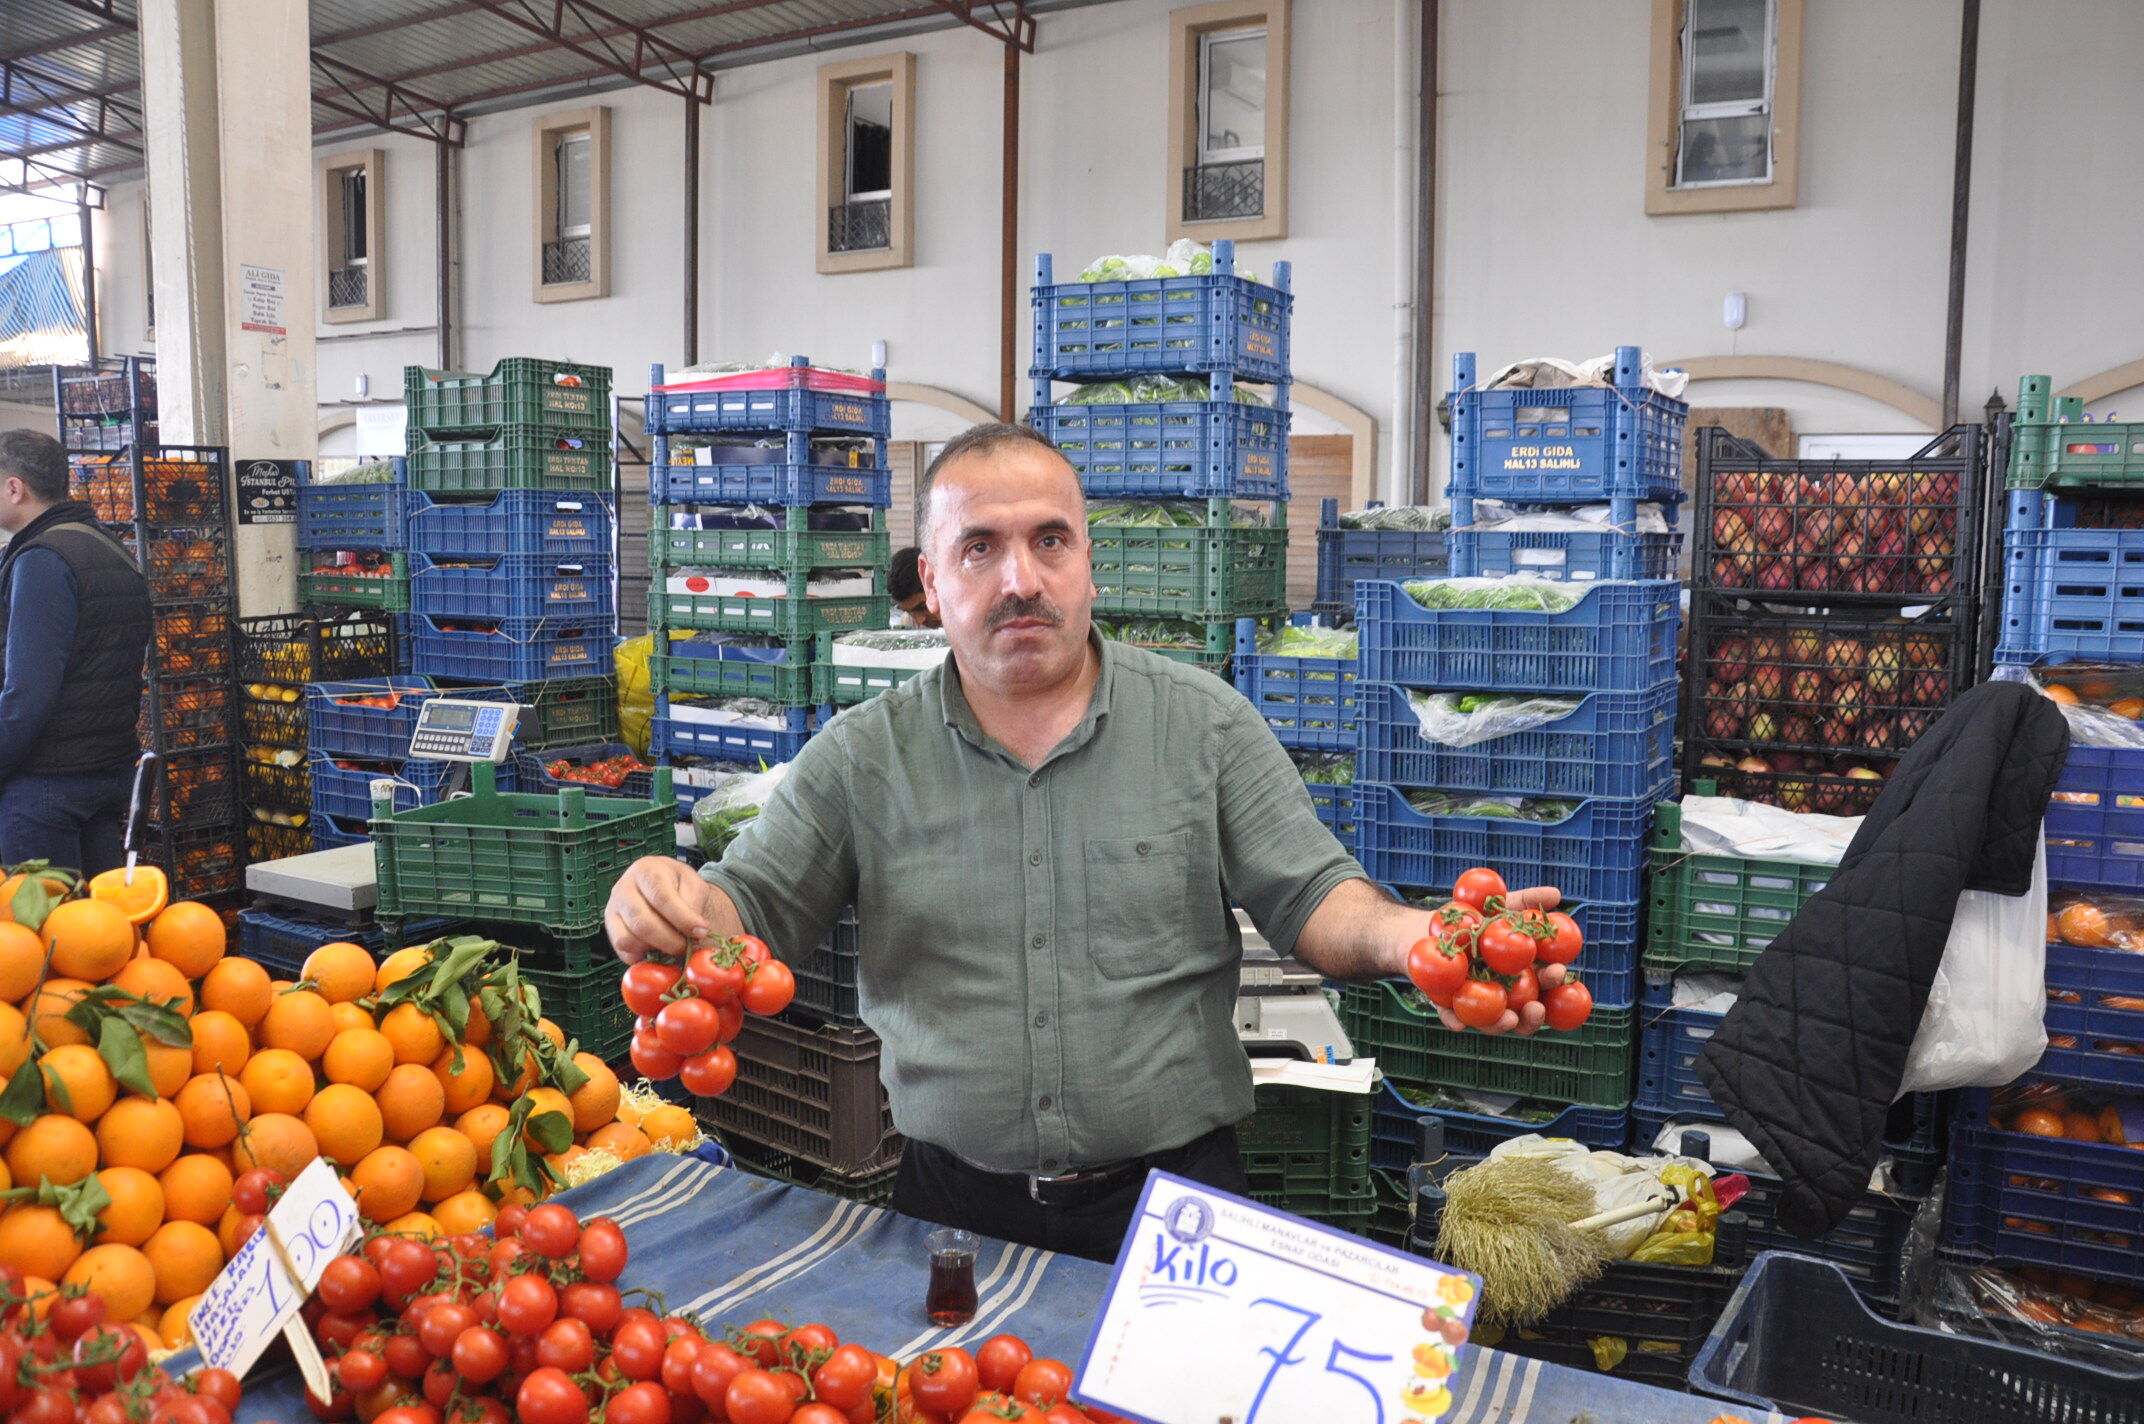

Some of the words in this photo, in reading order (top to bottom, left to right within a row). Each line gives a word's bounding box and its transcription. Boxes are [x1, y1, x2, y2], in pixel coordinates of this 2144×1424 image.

[261, 271, 280, 281] GIDA
[1542, 446, 1574, 457] GIDA
[240, 475, 277, 487] İSTANBUL
[568, 519, 582, 527] GIDA
[1261, 1221, 1319, 1249] MANAVLAR
[1320, 1242, 1331, 1252] ve
[1334, 1246, 1399, 1275] PAZARCILAR
[1270, 1238, 1304, 1256] ESNAF
[1306, 1249, 1341, 1269] ODASI
[1151, 1233, 1238, 1287] Kilo
[1248, 1297, 1394, 1424] 75
